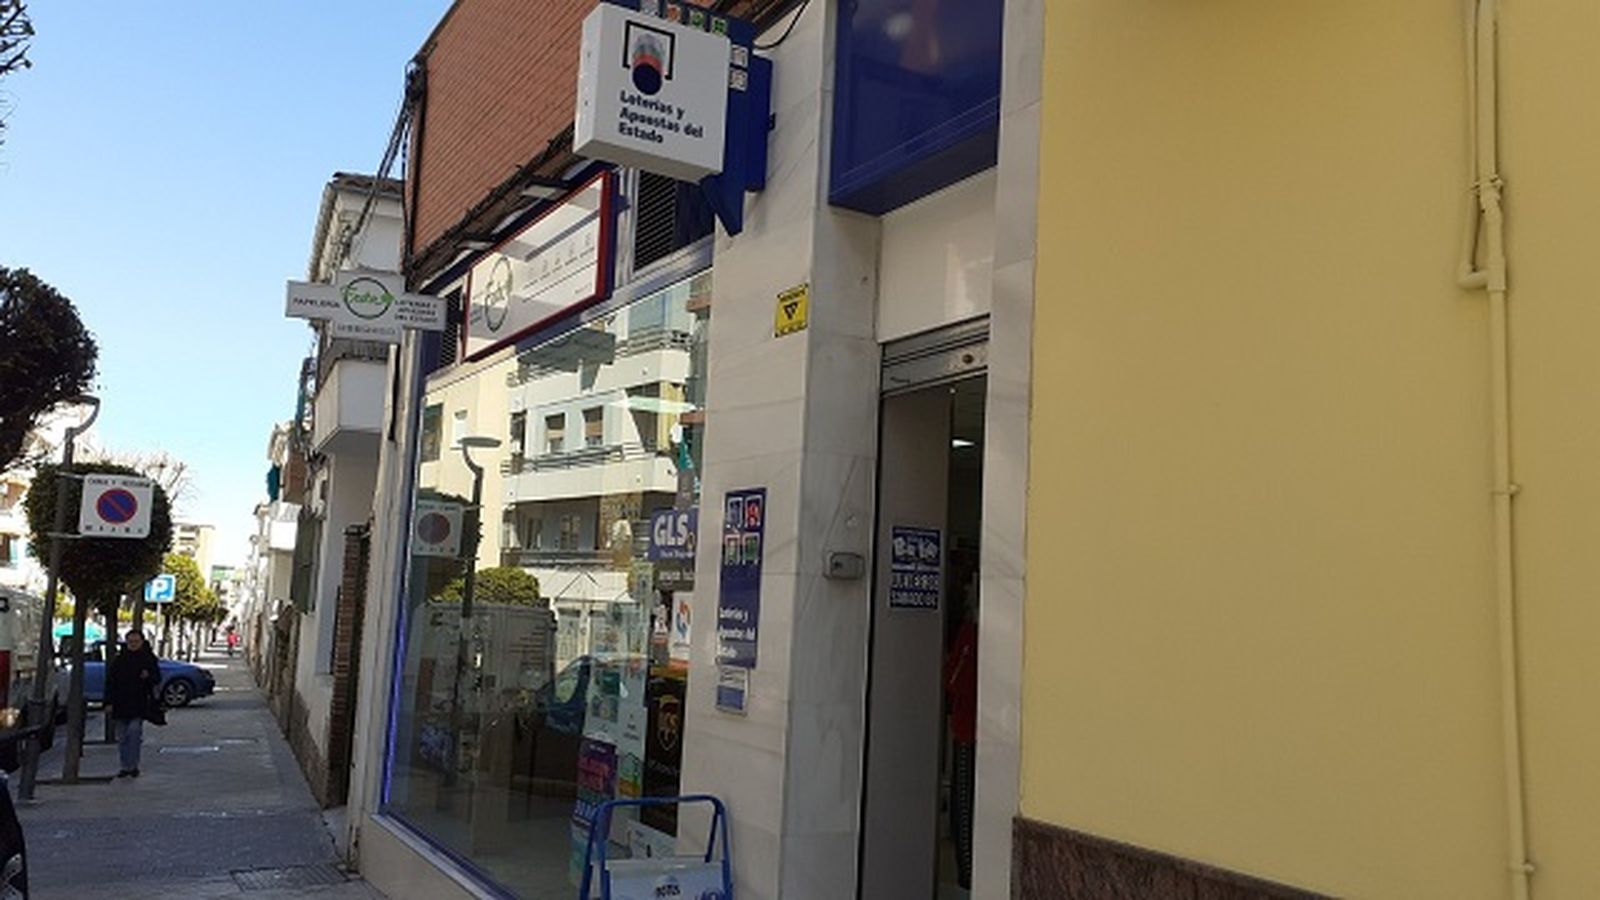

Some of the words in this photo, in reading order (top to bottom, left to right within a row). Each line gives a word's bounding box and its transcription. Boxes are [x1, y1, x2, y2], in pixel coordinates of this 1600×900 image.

[620, 107, 680, 133] Apuestas
[683, 123, 703, 138] del
[677, 107, 685, 121] y
[619, 121, 663, 143] Estado
[654, 514, 689, 547] GLS
[151, 579, 169, 600] P
